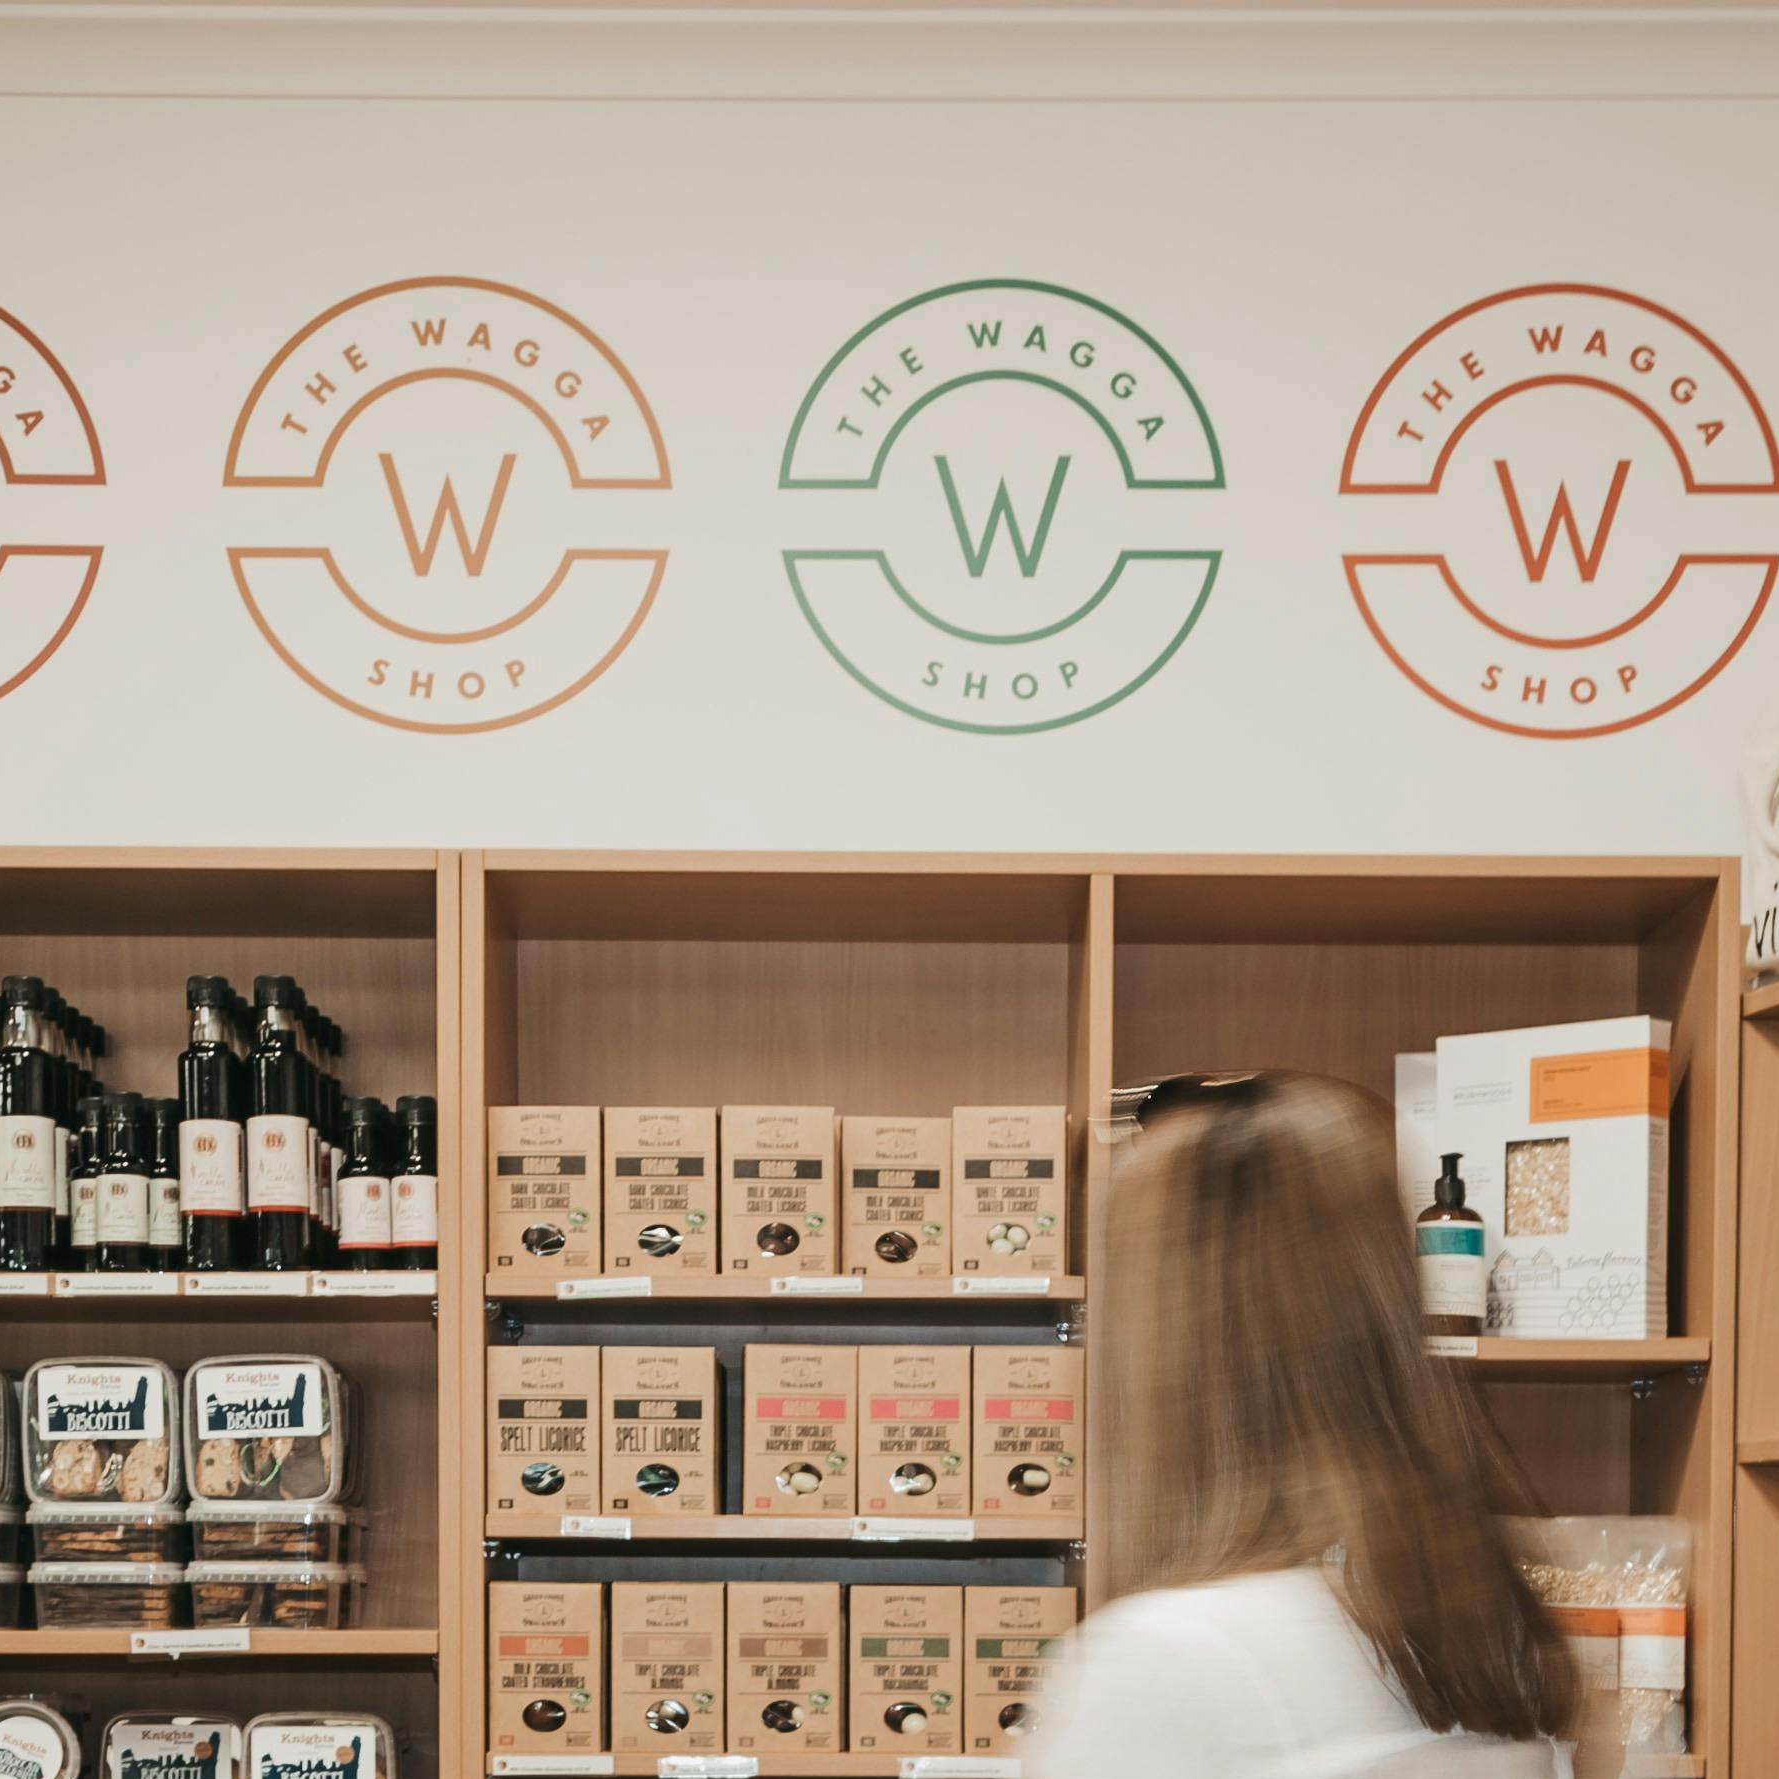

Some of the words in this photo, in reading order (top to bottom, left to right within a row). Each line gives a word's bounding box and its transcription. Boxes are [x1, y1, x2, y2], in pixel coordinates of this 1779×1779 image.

[280, 344, 367, 435] THE
[411, 319, 609, 440] WAGGA
[836, 347, 923, 437] THE
[968, 321, 1164, 440] WAGGA
[1398, 352, 1484, 441] THE
[1528, 325, 1725, 446] WAGGA
[378, 453, 518, 576] W
[933, 456, 1071, 577] W
[1494, 459, 1632, 583] W
[367, 660, 525, 700] SHOP
[922, 662, 1078, 700] SHOP
[1480, 664, 1638, 704] SHOP
[532, 1183, 571, 1196] CHOCOLATE
[650, 1184, 689, 1196] CHOCOLATE
[67, 1373, 122, 1386] Knights
[225, 1371, 280, 1384] Knights
[67, 1411, 131, 1432] BISCOTTI
[226, 1408, 290, 1430] BISCOTTI
[500, 1426, 533, 1453] SPELT
[539, 1426, 587, 1453] LICORICE
[615, 1427, 648, 1453] SPELT
[654, 1427, 701, 1453] LICORICE
[141, 1729, 195, 1742] Knights
[280, 1732, 335, 1746] Knights
